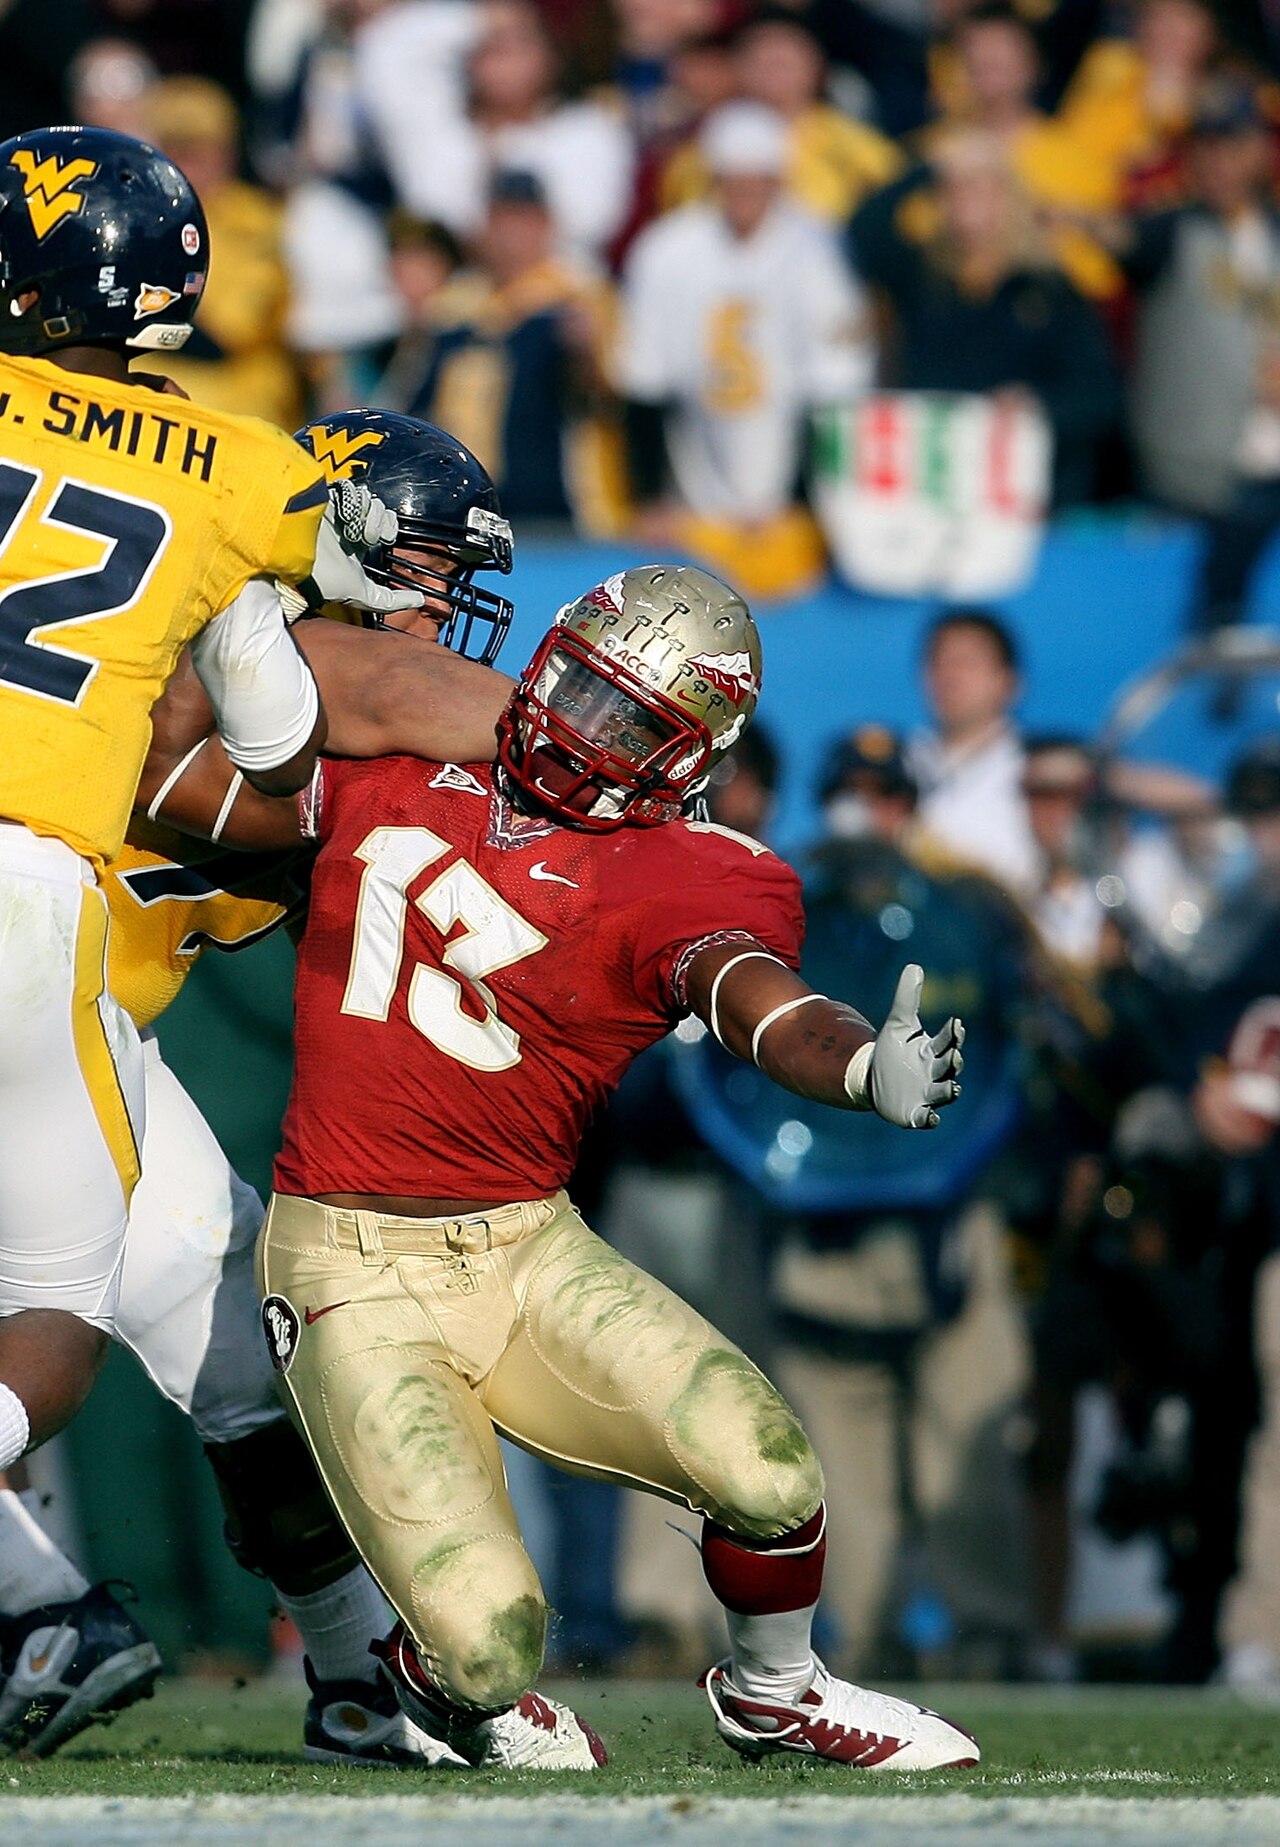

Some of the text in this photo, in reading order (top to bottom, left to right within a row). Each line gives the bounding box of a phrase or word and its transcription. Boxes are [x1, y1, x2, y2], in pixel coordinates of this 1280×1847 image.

[43, 391, 217, 483] SMITH
[613, 649, 650, 676] ACC
[339, 826, 550, 1073] 13
